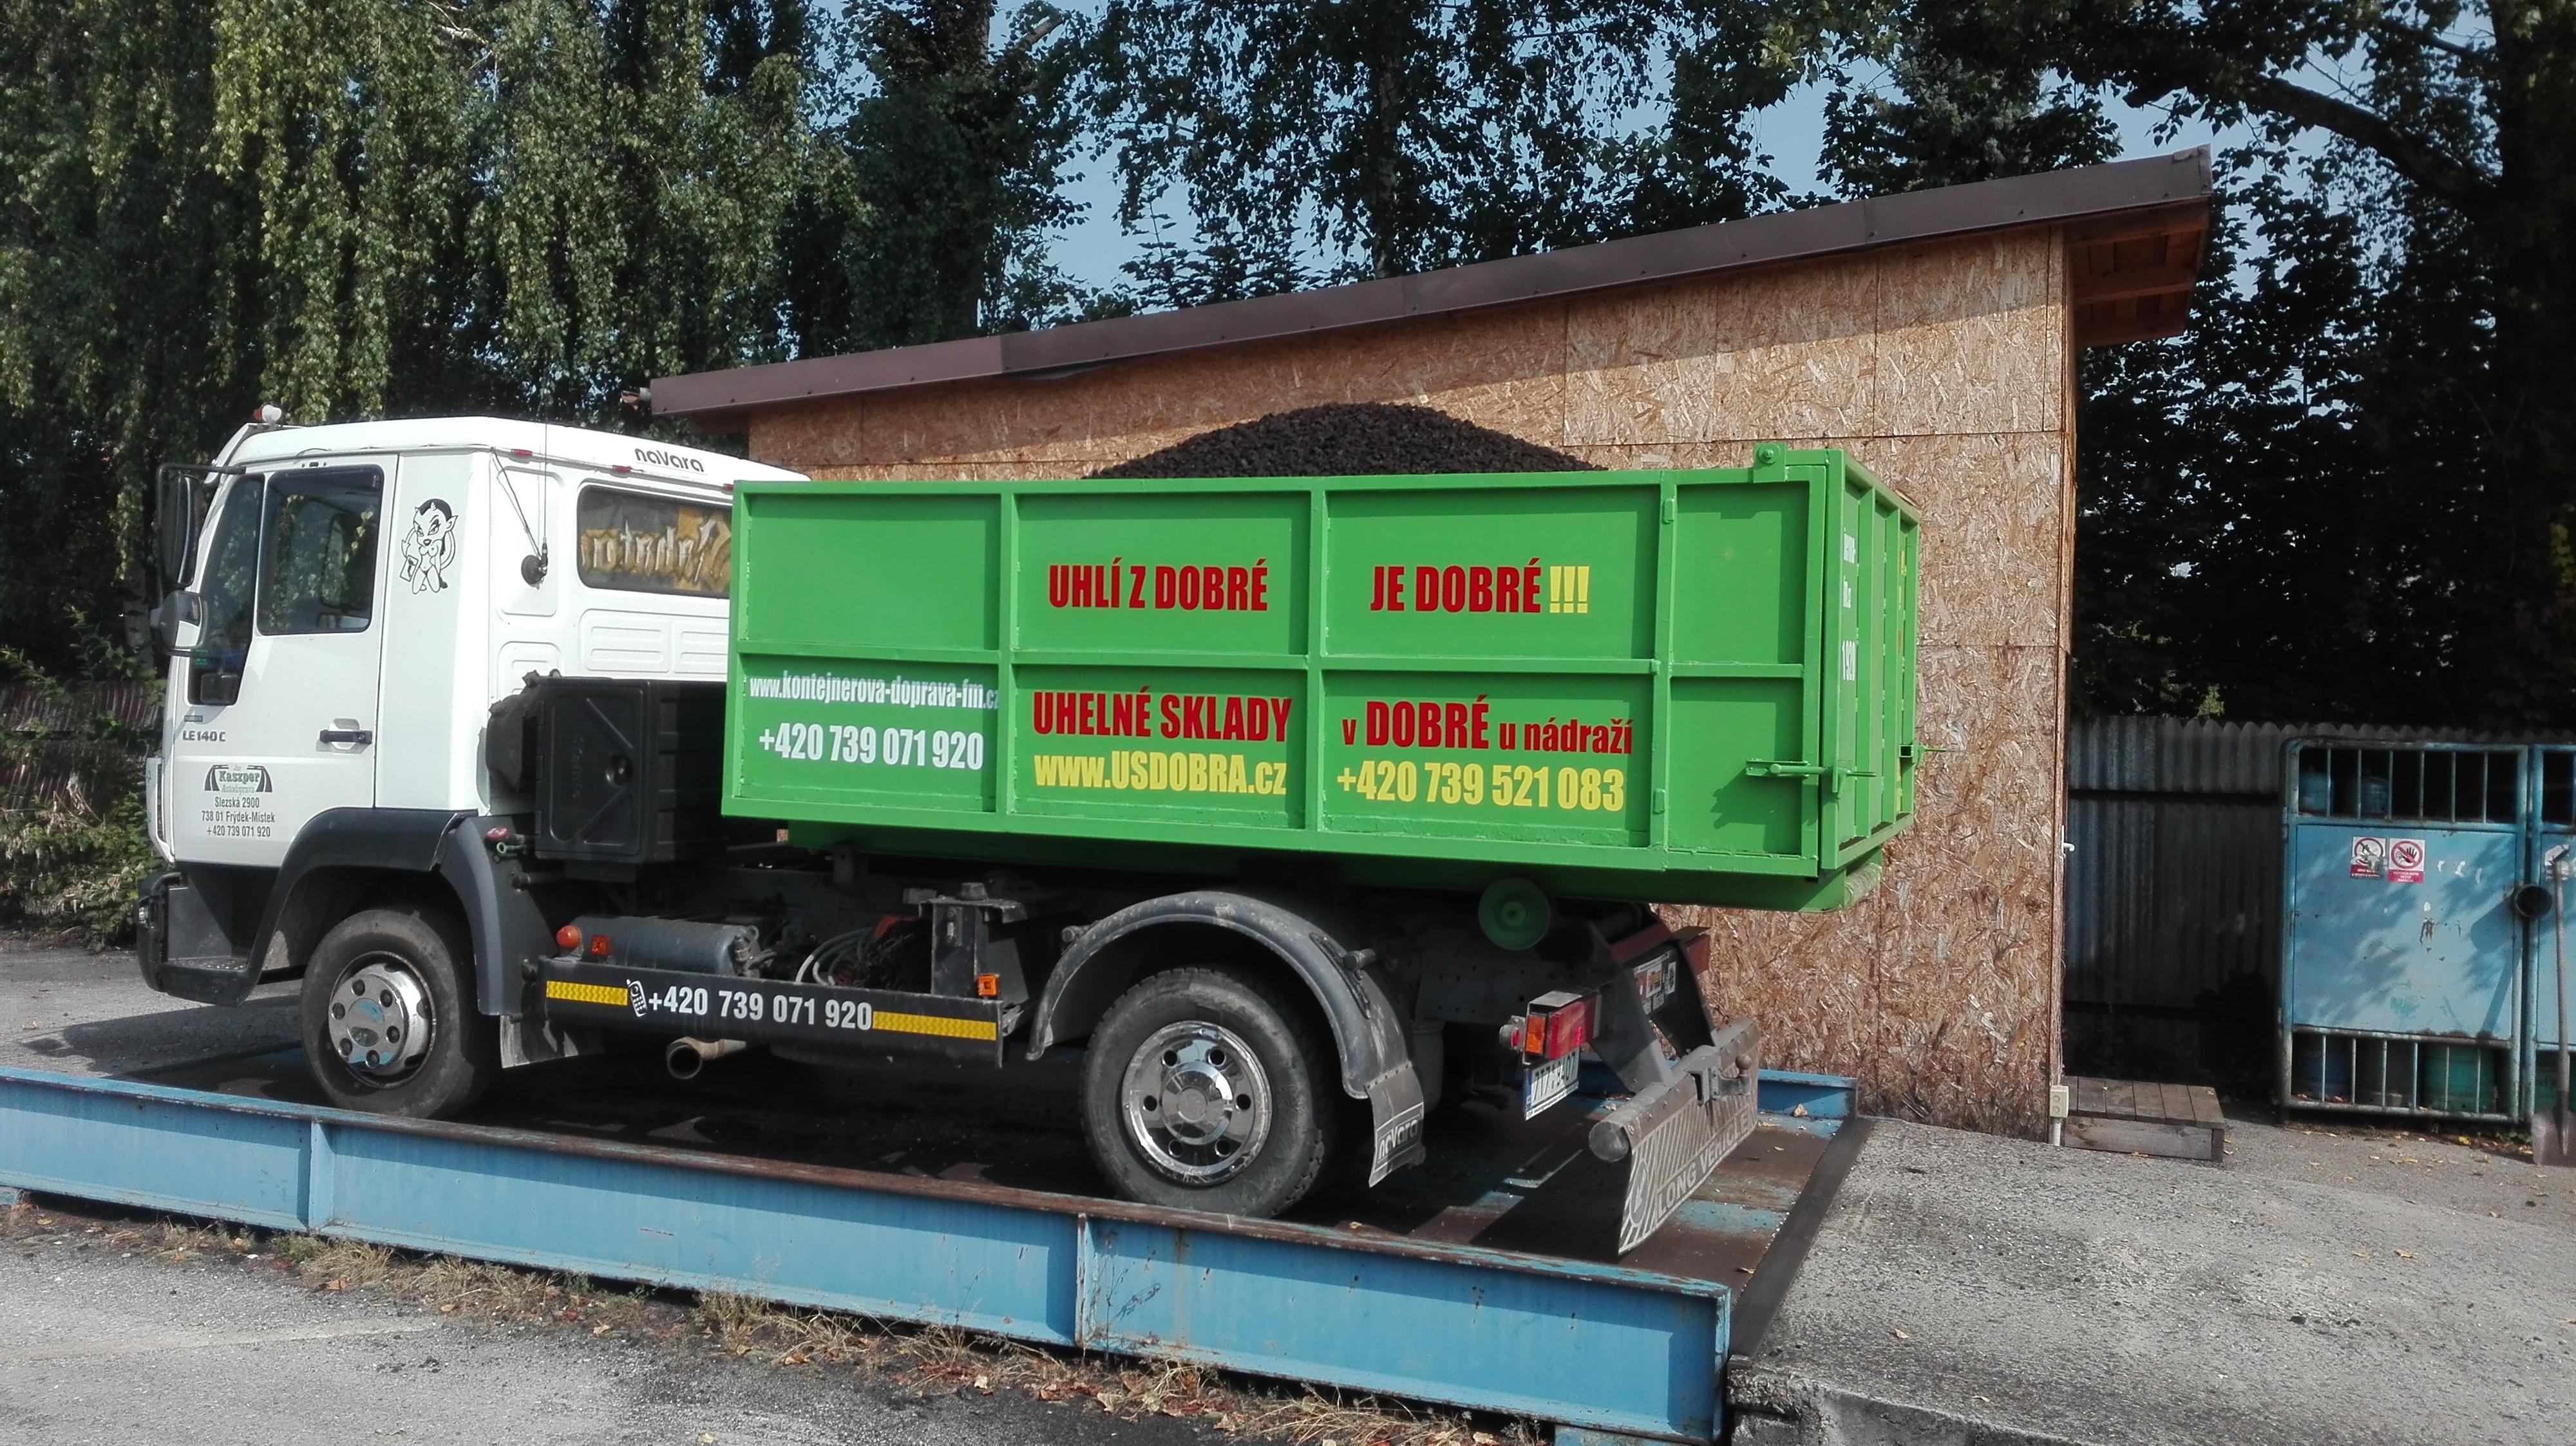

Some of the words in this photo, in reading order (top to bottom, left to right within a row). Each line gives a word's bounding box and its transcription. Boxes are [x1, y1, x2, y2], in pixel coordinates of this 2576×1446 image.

[1048, 556, 1122, 608] UHLÍ
[1128, 566, 1146, 608] Z
[1155, 558, 1267, 612] DOBRÉ
[1370, 566, 1405, 611] JE
[1415, 558, 1541, 614] DOBRÉ
[1549, 565, 1590, 614] !!!
[1033, 686, 1151, 737] UHELNÉ
[1160, 694, 1292, 742] SKLADY
[1342, 718, 1357, 746] v
[1366, 695, 1490, 749] DOBRÉ
[1499, 722, 1516, 750] u
[1524, 717, 1634, 755] nádraží
[759, 722, 824, 760] +420
[829, 725, 876, 763] 739
[883, 728, 926, 766] 071
[932, 730, 984, 771] 920
[214, 796, 240, 807] Slezská
[242, 797, 260, 808] 2900
[219, 771, 260, 784] Kaszper
[1337, 760, 1417, 802] +420
[1424, 762, 1484, 805] 739
[1492, 764, 1549, 807] 521
[1557, 767, 1624, 812] 083
[202, 811, 214, 822] 738
[216, 811, 223, 822] 01
[207, 825, 225, 836] +420
[227, 825, 240, 837] 739
[242, 826, 254, 837] 071
[257, 826, 270, 838] 920
[649, 986, 708, 1015] +420
[719, 990, 763, 1020] 739
[773, 995, 815, 1025] 071
[825, 1000, 872, 1030] 920
[1658, 1161, 1697, 1216] LONG
[1700, 1112, 1748, 1174] VEHICLE
